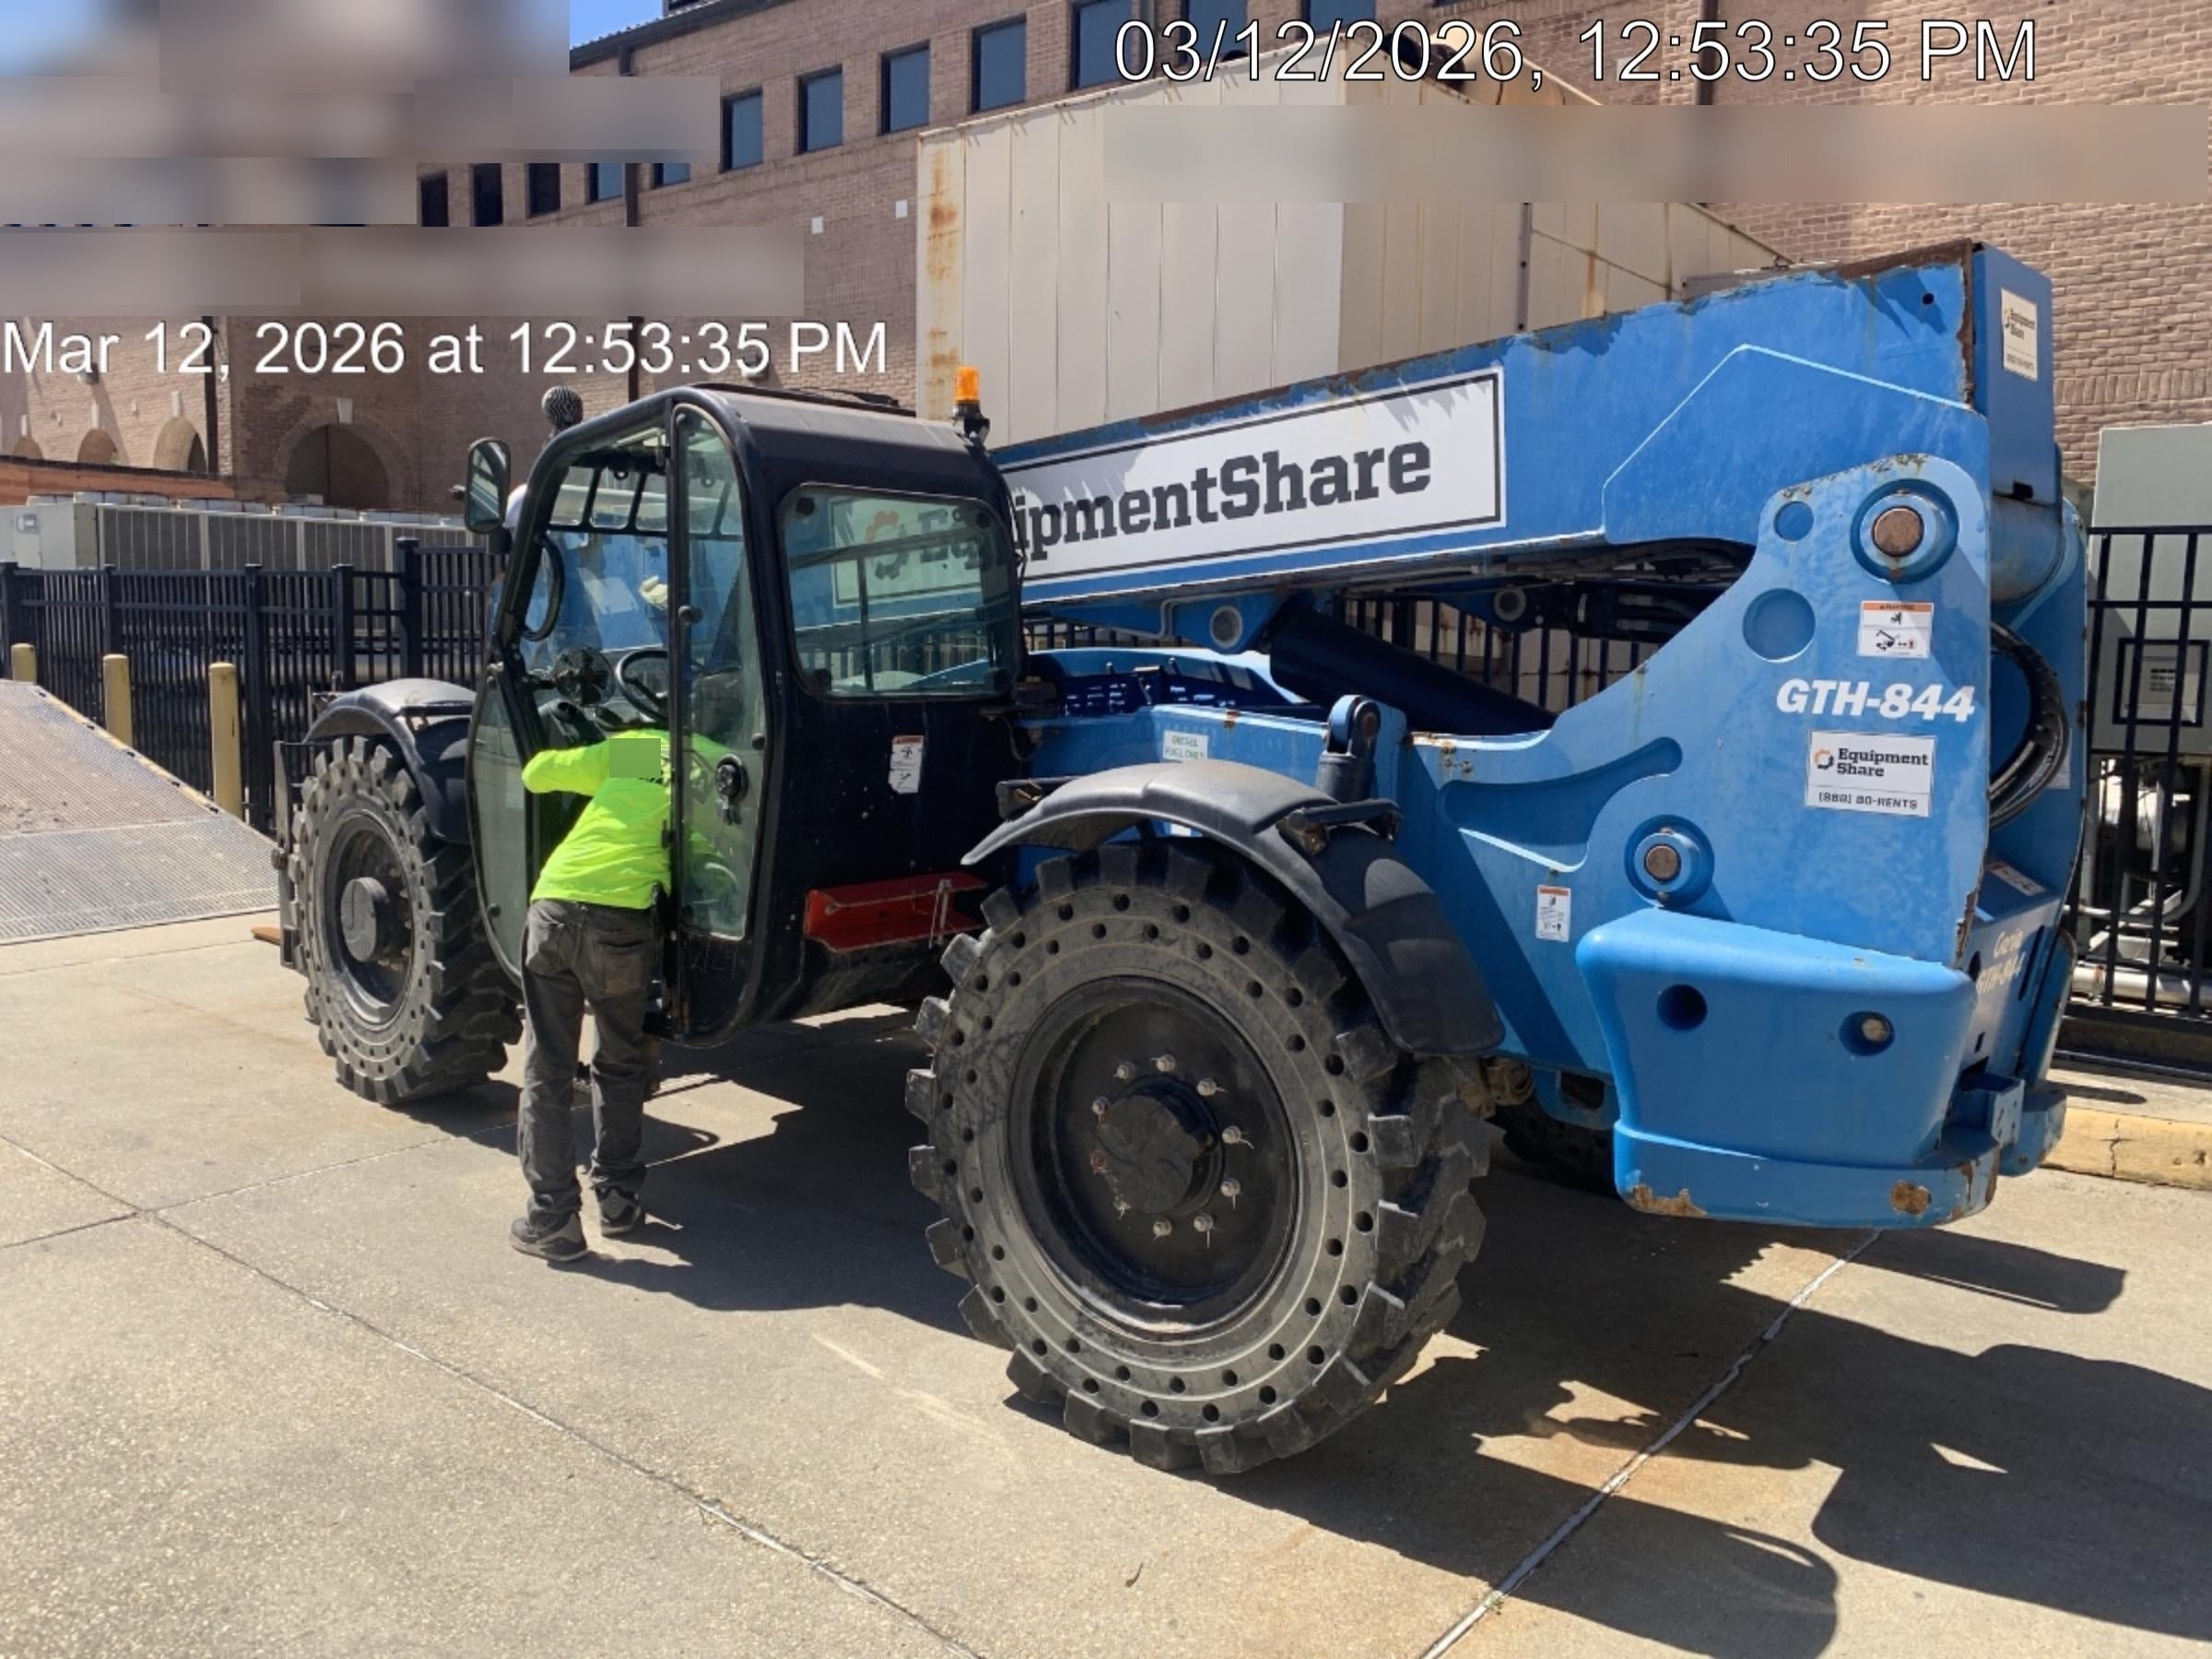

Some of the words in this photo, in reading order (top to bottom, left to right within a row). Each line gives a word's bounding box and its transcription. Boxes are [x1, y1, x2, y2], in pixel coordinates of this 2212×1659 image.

[1776, 678, 1975, 722] GTH-844
[1838, 747, 1929, 766] Equipment
[1837, 762, 1885, 777] Share
